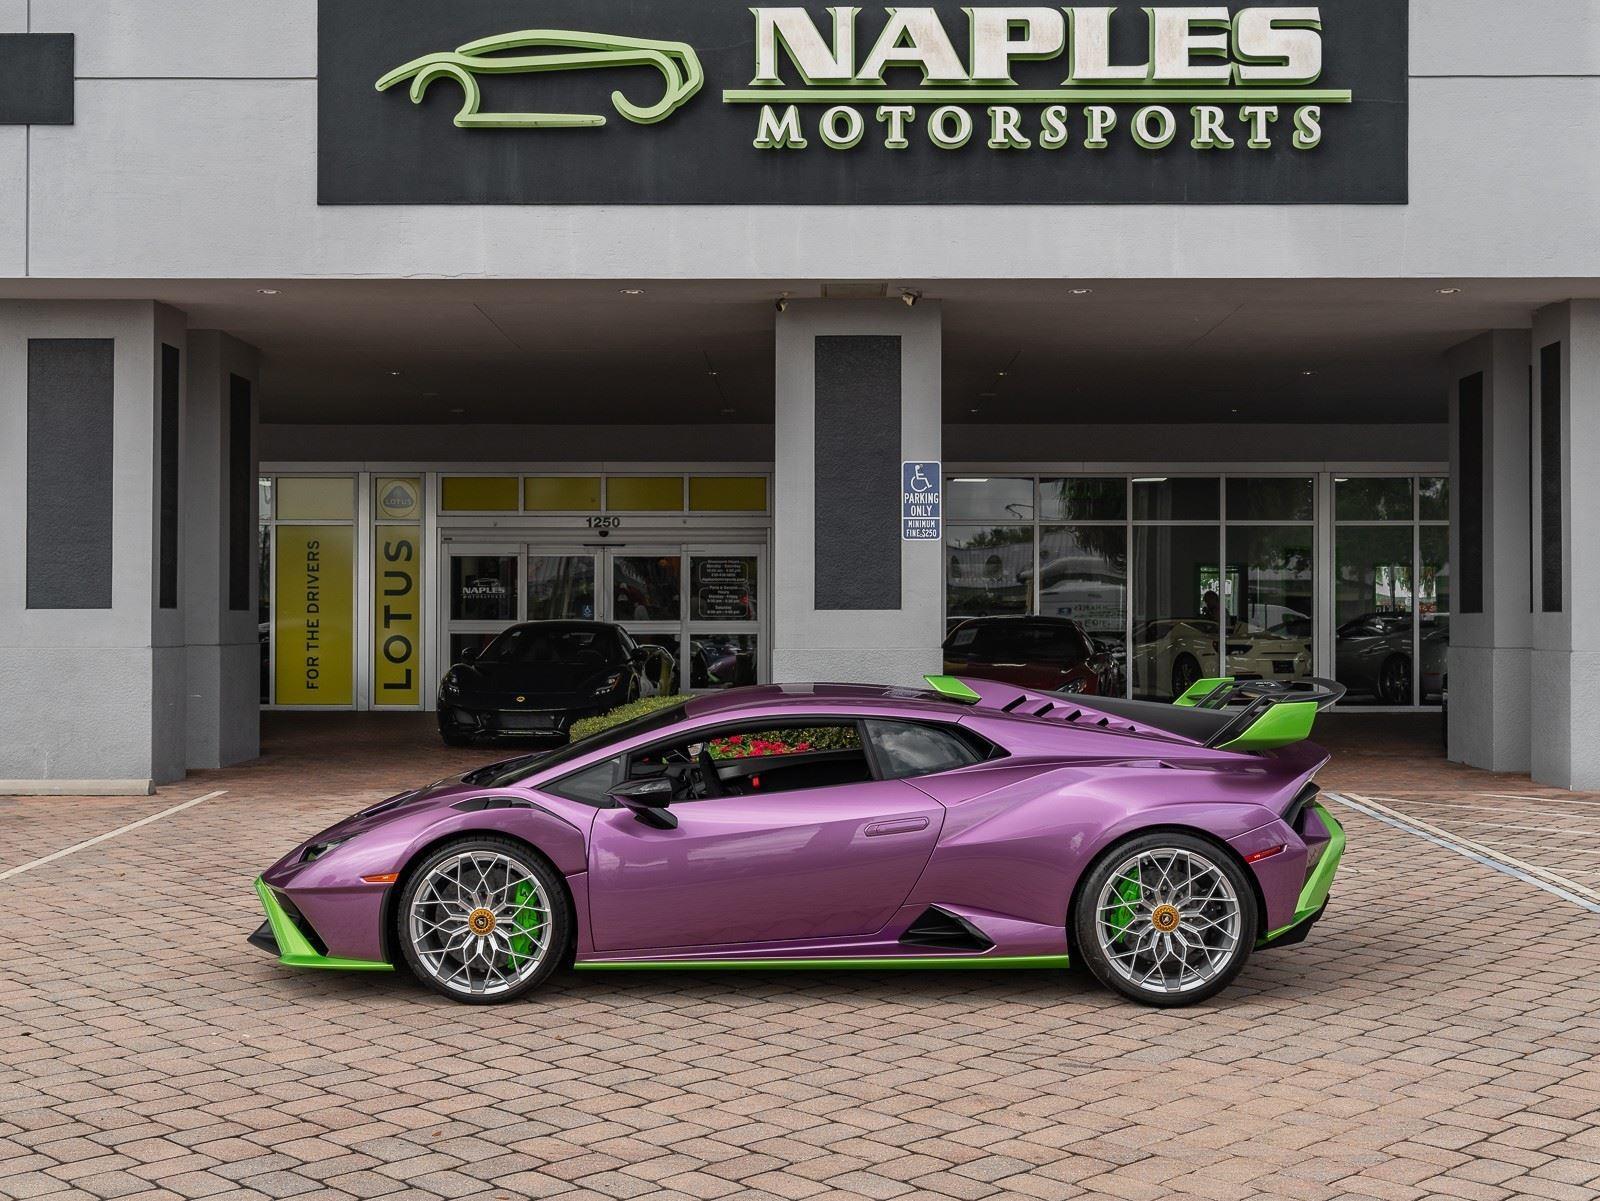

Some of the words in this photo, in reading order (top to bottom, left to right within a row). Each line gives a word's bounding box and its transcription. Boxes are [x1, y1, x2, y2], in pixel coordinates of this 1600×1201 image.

[749, 6, 1323, 86] NAPLES
[752, 104, 1323, 150] MOTORSPORTS
[904, 493, 939, 504] PARKING
[910, 505, 933, 517] ONLY
[586, 517, 620, 528] 1250
[908, 520, 936, 528] MINIMUM
[306, 540, 320, 614] DRIVERS
[462, 586, 505, 594] NAPLES
[383, 540, 413, 690] LOTUS
[306, 618, 319, 651] THE
[306, 656, 319, 690] FOR
